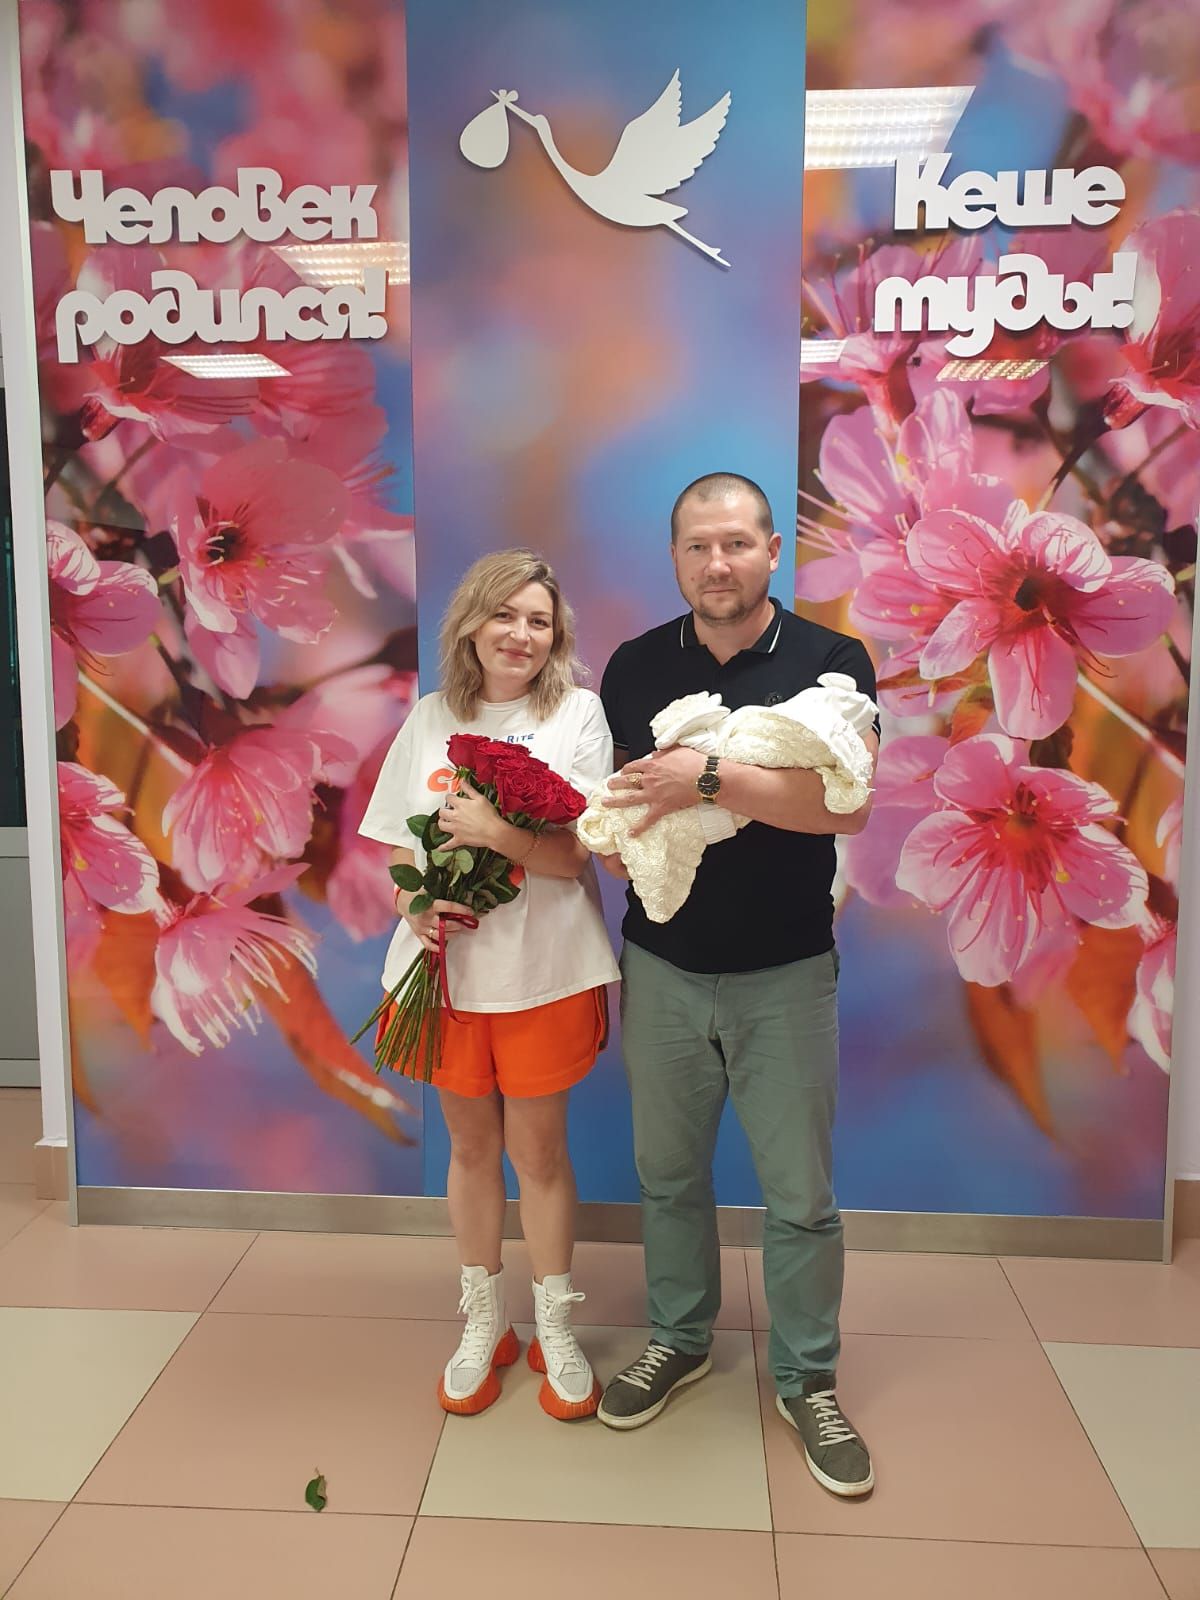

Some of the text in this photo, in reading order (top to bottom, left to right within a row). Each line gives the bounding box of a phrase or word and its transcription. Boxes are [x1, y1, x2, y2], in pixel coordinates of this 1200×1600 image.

[50, 168, 378, 243] Человек
[895, 152, 1126, 231] Кеше
[56, 268, 388, 362] родился!
[875, 252, 1138, 357] туды!
